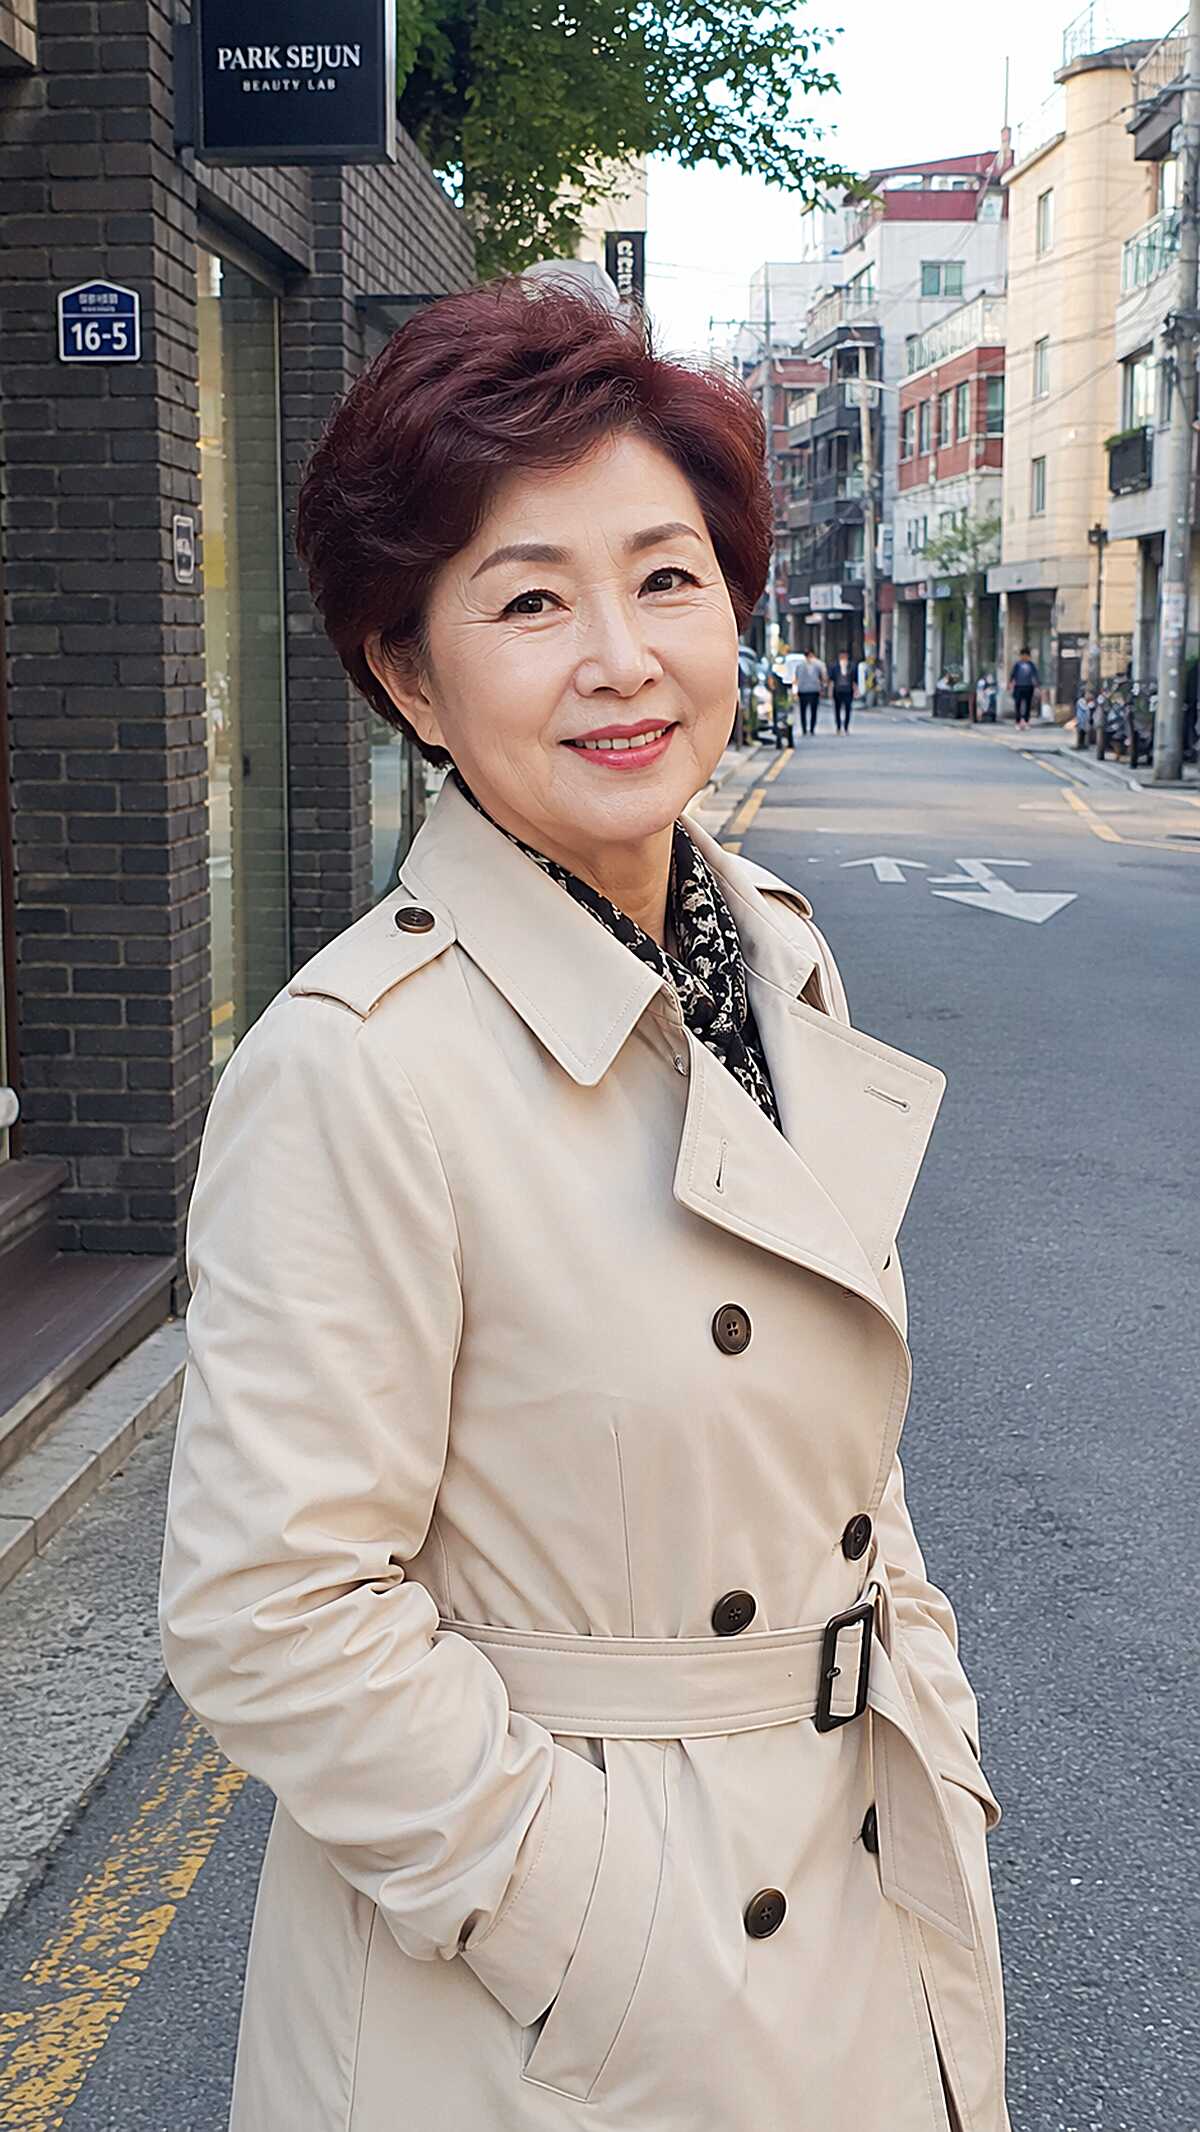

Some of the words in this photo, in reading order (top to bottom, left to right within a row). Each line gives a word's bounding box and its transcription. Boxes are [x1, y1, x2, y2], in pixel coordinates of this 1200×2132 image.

[218, 46, 282, 70] PARK
[286, 44, 361, 73] SEJUN
[242, 79, 300, 92] BEAUTY
[307, 78, 336, 90] LAB
[71, 321, 128, 351] 16-5
